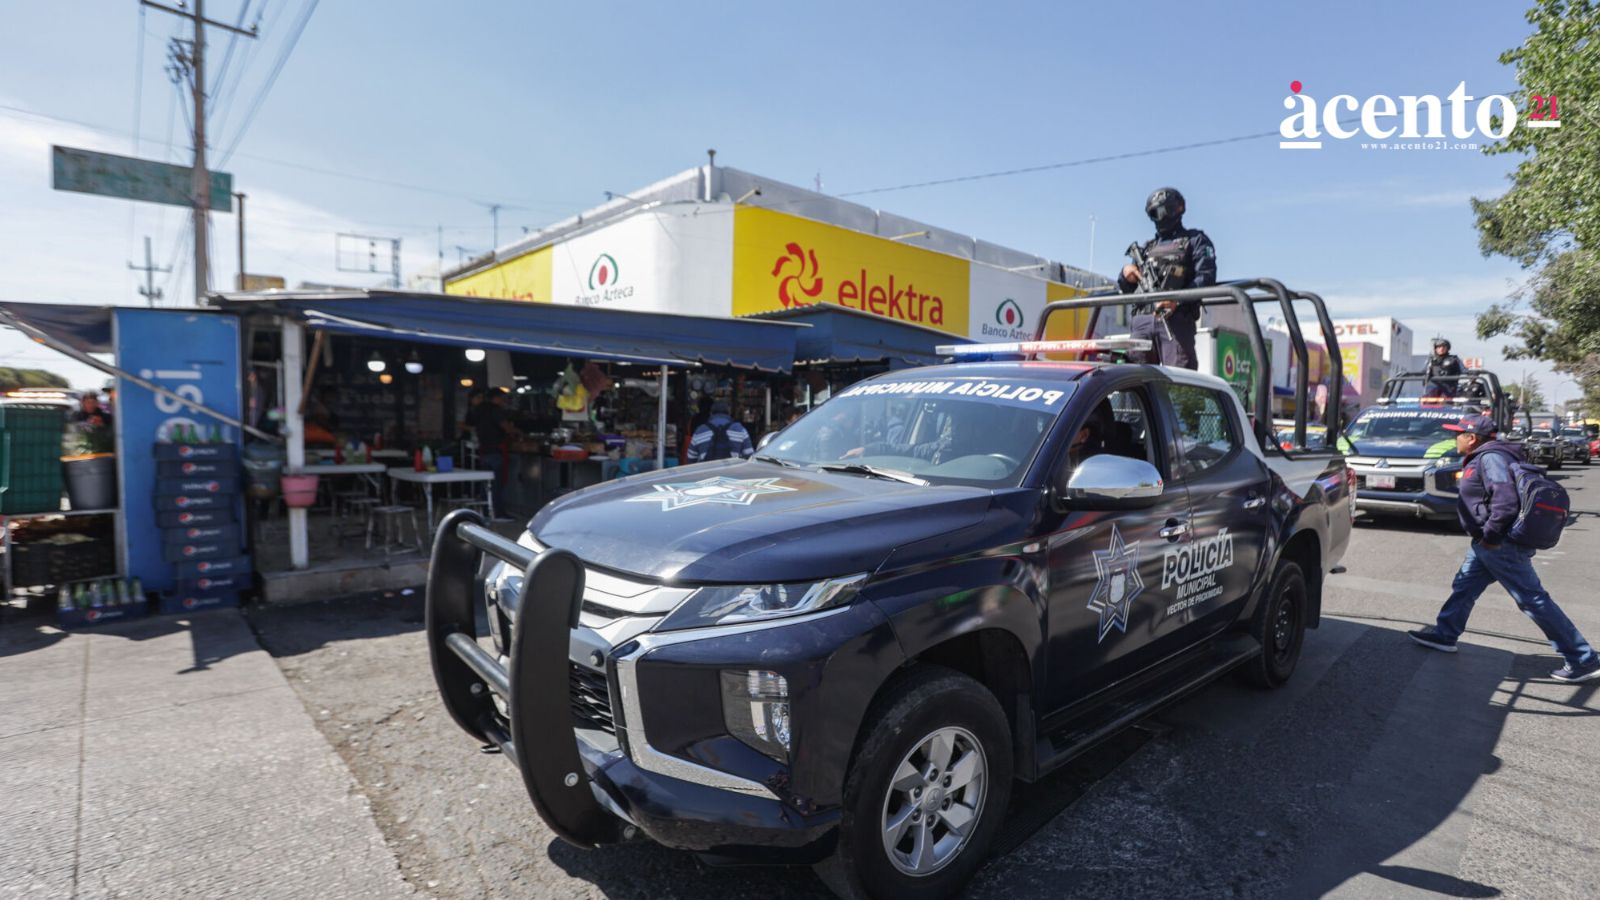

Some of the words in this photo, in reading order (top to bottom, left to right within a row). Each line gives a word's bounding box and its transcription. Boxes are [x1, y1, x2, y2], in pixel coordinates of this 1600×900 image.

[838, 269, 943, 325] elektra
[982, 323, 1008, 338] Banco
[1009, 328, 1035, 341] Aztec
[1319, 323, 1378, 337] OTEL
[1161, 527, 1233, 590] POLICÍA
[1177, 573, 1216, 599] MUNICIPAL
[1167, 600, 1187, 615] VECTOR
[1187, 597, 1195, 607] DE
